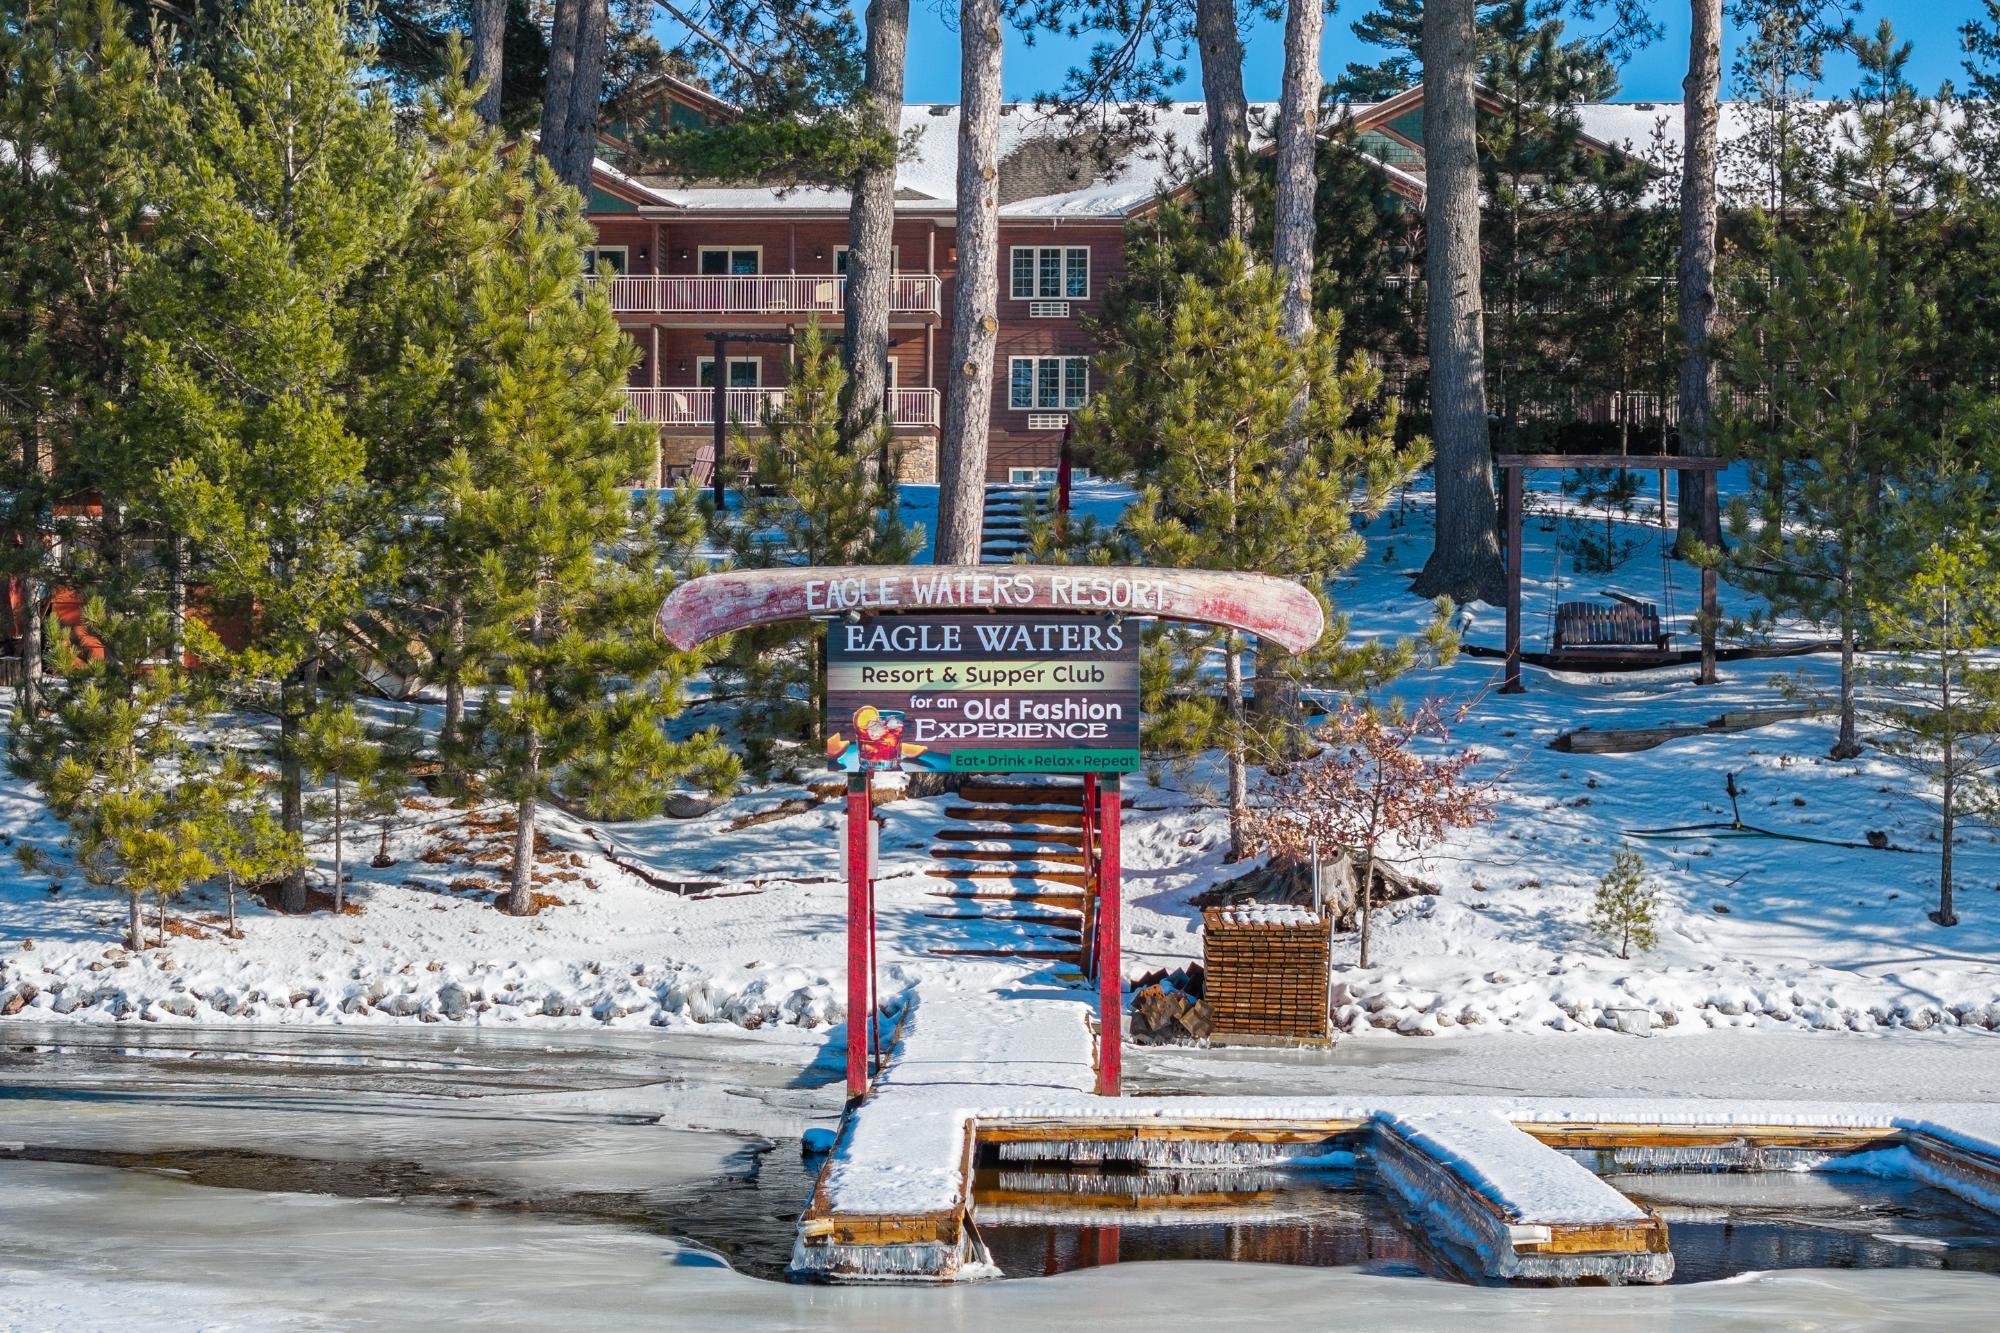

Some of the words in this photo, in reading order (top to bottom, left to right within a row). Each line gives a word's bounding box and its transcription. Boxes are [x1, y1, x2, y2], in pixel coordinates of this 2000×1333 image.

[805, 576, 899, 611] EAGLE
[912, 573, 1035, 605] WATERS
[1051, 575, 1171, 611] RESORT
[843, 624, 963, 653] EAGLE
[973, 624, 1124, 652] WATERS
[862, 666, 935, 683] Resort
[942, 666, 958, 683] &
[966, 666, 1046, 687] Supper
[1052, 664, 1105, 683] Club
[910, 695, 933, 709] for
[936, 697, 958, 709] an
[963, 698, 1010, 721] Old
[1019, 698, 1122, 720] Fashion
[915, 718, 1109, 742] EXPERIENCE
